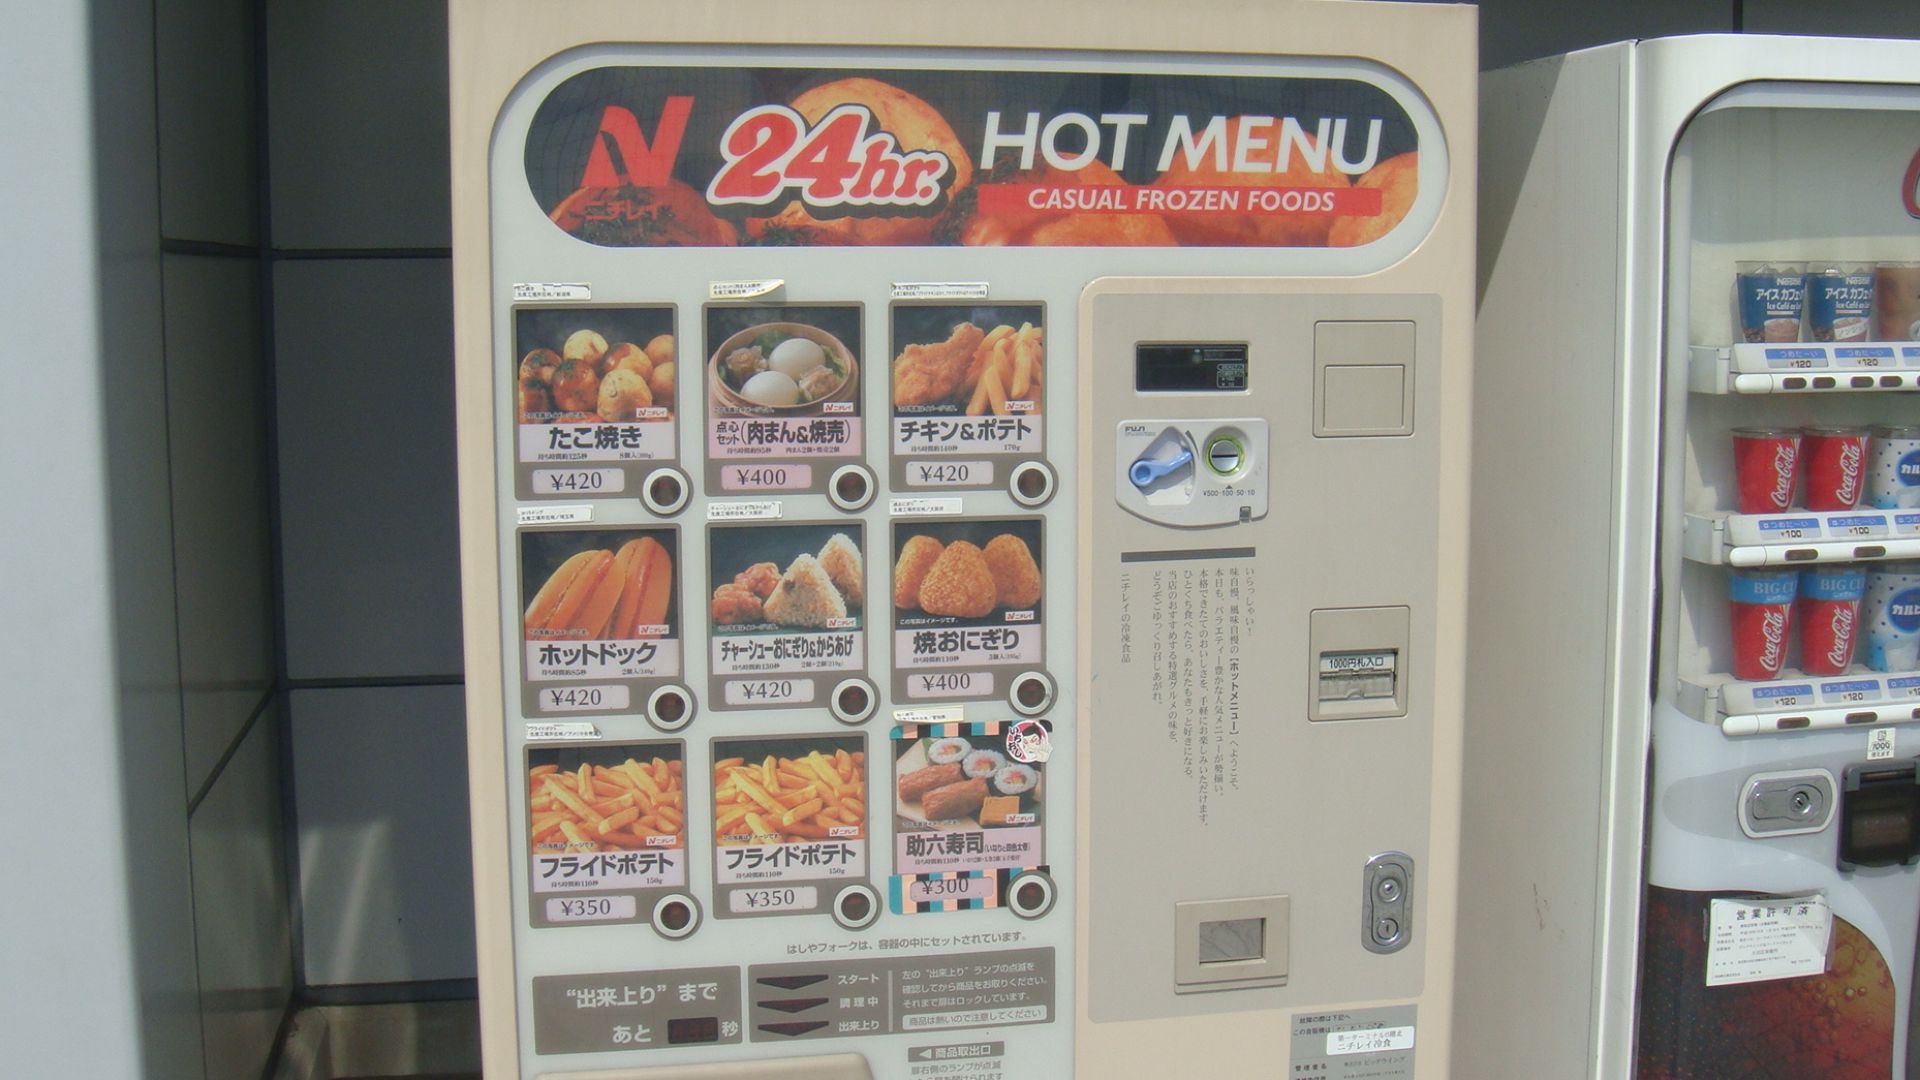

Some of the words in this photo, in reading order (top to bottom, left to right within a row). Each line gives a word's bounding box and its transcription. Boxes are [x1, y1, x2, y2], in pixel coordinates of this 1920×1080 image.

[980, 112, 1148, 172] HOT
[1157, 115, 1382, 175] MENU
[1028, 189, 1128, 211] CASUAL
[1136, 190, 1239, 212] FROZEN
[1247, 191, 1335, 212] FOODS
[1756, 288, 1780, 300] アイス
[1825, 287, 1849, 299] アイス
[1790, 360, 1812, 368] ¥120
[1857, 358, 1879, 366] ¥120
[716, 421, 739, 434] 点心
[900, 418, 1032, 443] チキン&ポテト
[549, 425, 642, 450] たこ焼き
[716, 434, 739, 445] セット
[551, 471, 603, 491] ¥420
[737, 468, 787, 486] ¥400
[920, 464, 969, 482] ¥420
[1781, 530, 1802, 538] ¥100
[1849, 526, 1870, 535] ¥100
[912, 628, 1020, 654] 焼おにぎり
[539, 642, 658, 666] ホットドック
[1329, 657, 1385, 668] 1000円札入口
[742, 681, 792, 700] ¥420
[922, 673, 971, 691] ¥400
[551, 689, 602, 706] ¥420
[1775, 697, 1797, 706] ¥120
[1843, 692, 1864, 701] ¥120
[906, 832, 984, 857] 助六寿司
[540, 853, 674, 878] フライドポテト
[725, 843, 856, 870] フライドポテト
[922, 877, 969, 895] ¥300
[745, 889, 795, 907] ¥350
[561, 899, 611, 916] ¥350
[786, 932, 1027, 955] はしやフォークは、容器の中にセットされています。
[838, 973, 880, 986] スタート
[678, 982, 718, 1002] まで
[839, 996, 879, 1009] 調理中
[612, 1024, 652, 1044] あと
[721, 1020, 739, 1038] 秒
[838, 1020, 880, 1033] 出来上り
[935, 1045, 991, 1059] 商品取出口
